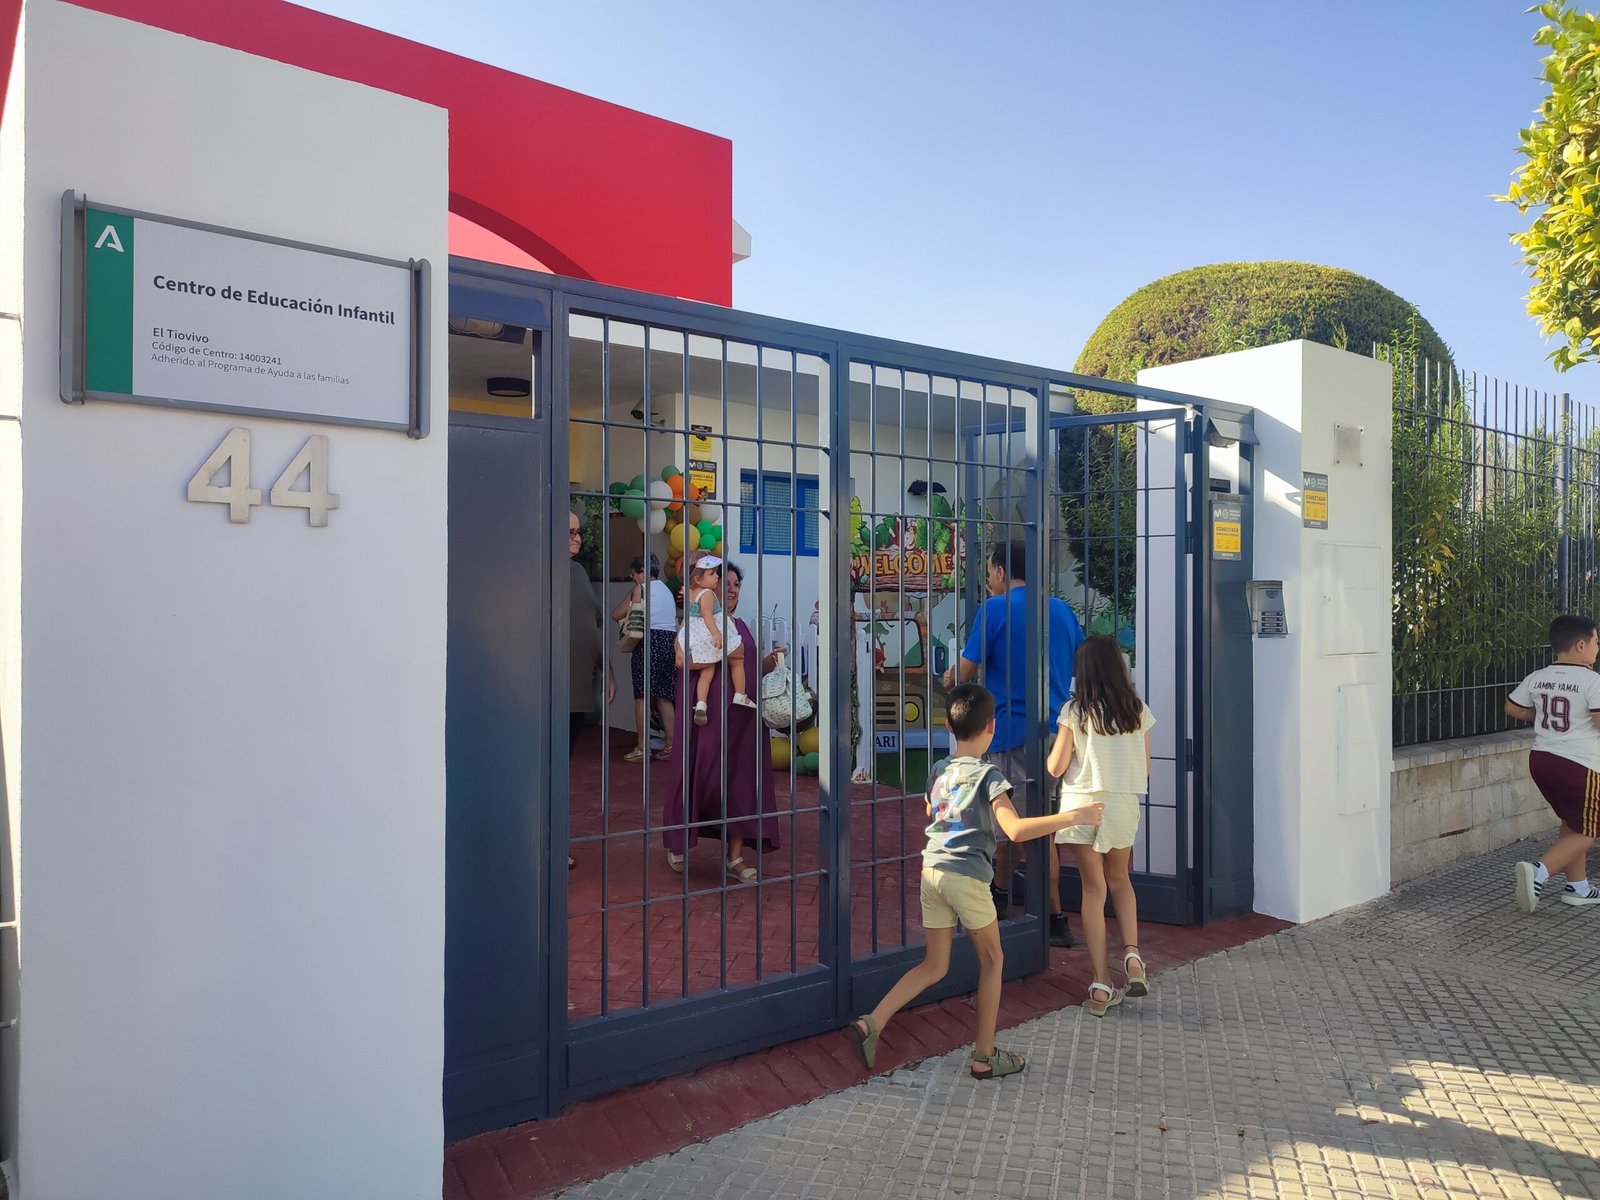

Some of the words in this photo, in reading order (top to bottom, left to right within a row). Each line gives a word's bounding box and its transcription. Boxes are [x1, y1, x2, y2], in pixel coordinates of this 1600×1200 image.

[153, 275, 216, 297] Centro
[221, 285, 243, 301] de
[247, 289, 334, 315] Educación
[338, 304, 395, 325] Infantil
[153, 327, 164, 338] El
[166, 329, 209, 343] Tiovivo
[151, 341, 187, 355] Código
[188, 346, 201, 355] de
[202, 348, 237, 359] Centro:
[239, 353, 282, 365] 14003241
[151, 353, 195, 366] Adherido
[197, 359, 206, 367] al
[208, 360, 253, 373] Programa
[254, 366, 266, 374] de
[267, 367, 295, 378] Ayuda
[303, 371, 316, 381] las
[317, 372, 350, 385] familias
[187, 427, 340, 527] 44
[855, 552, 952, 575] WELCOME
[1534, 682, 1556, 690] LAMINE
[1557, 683, 1580, 693] YAMAL
[1540, 693, 1570, 732] 19
